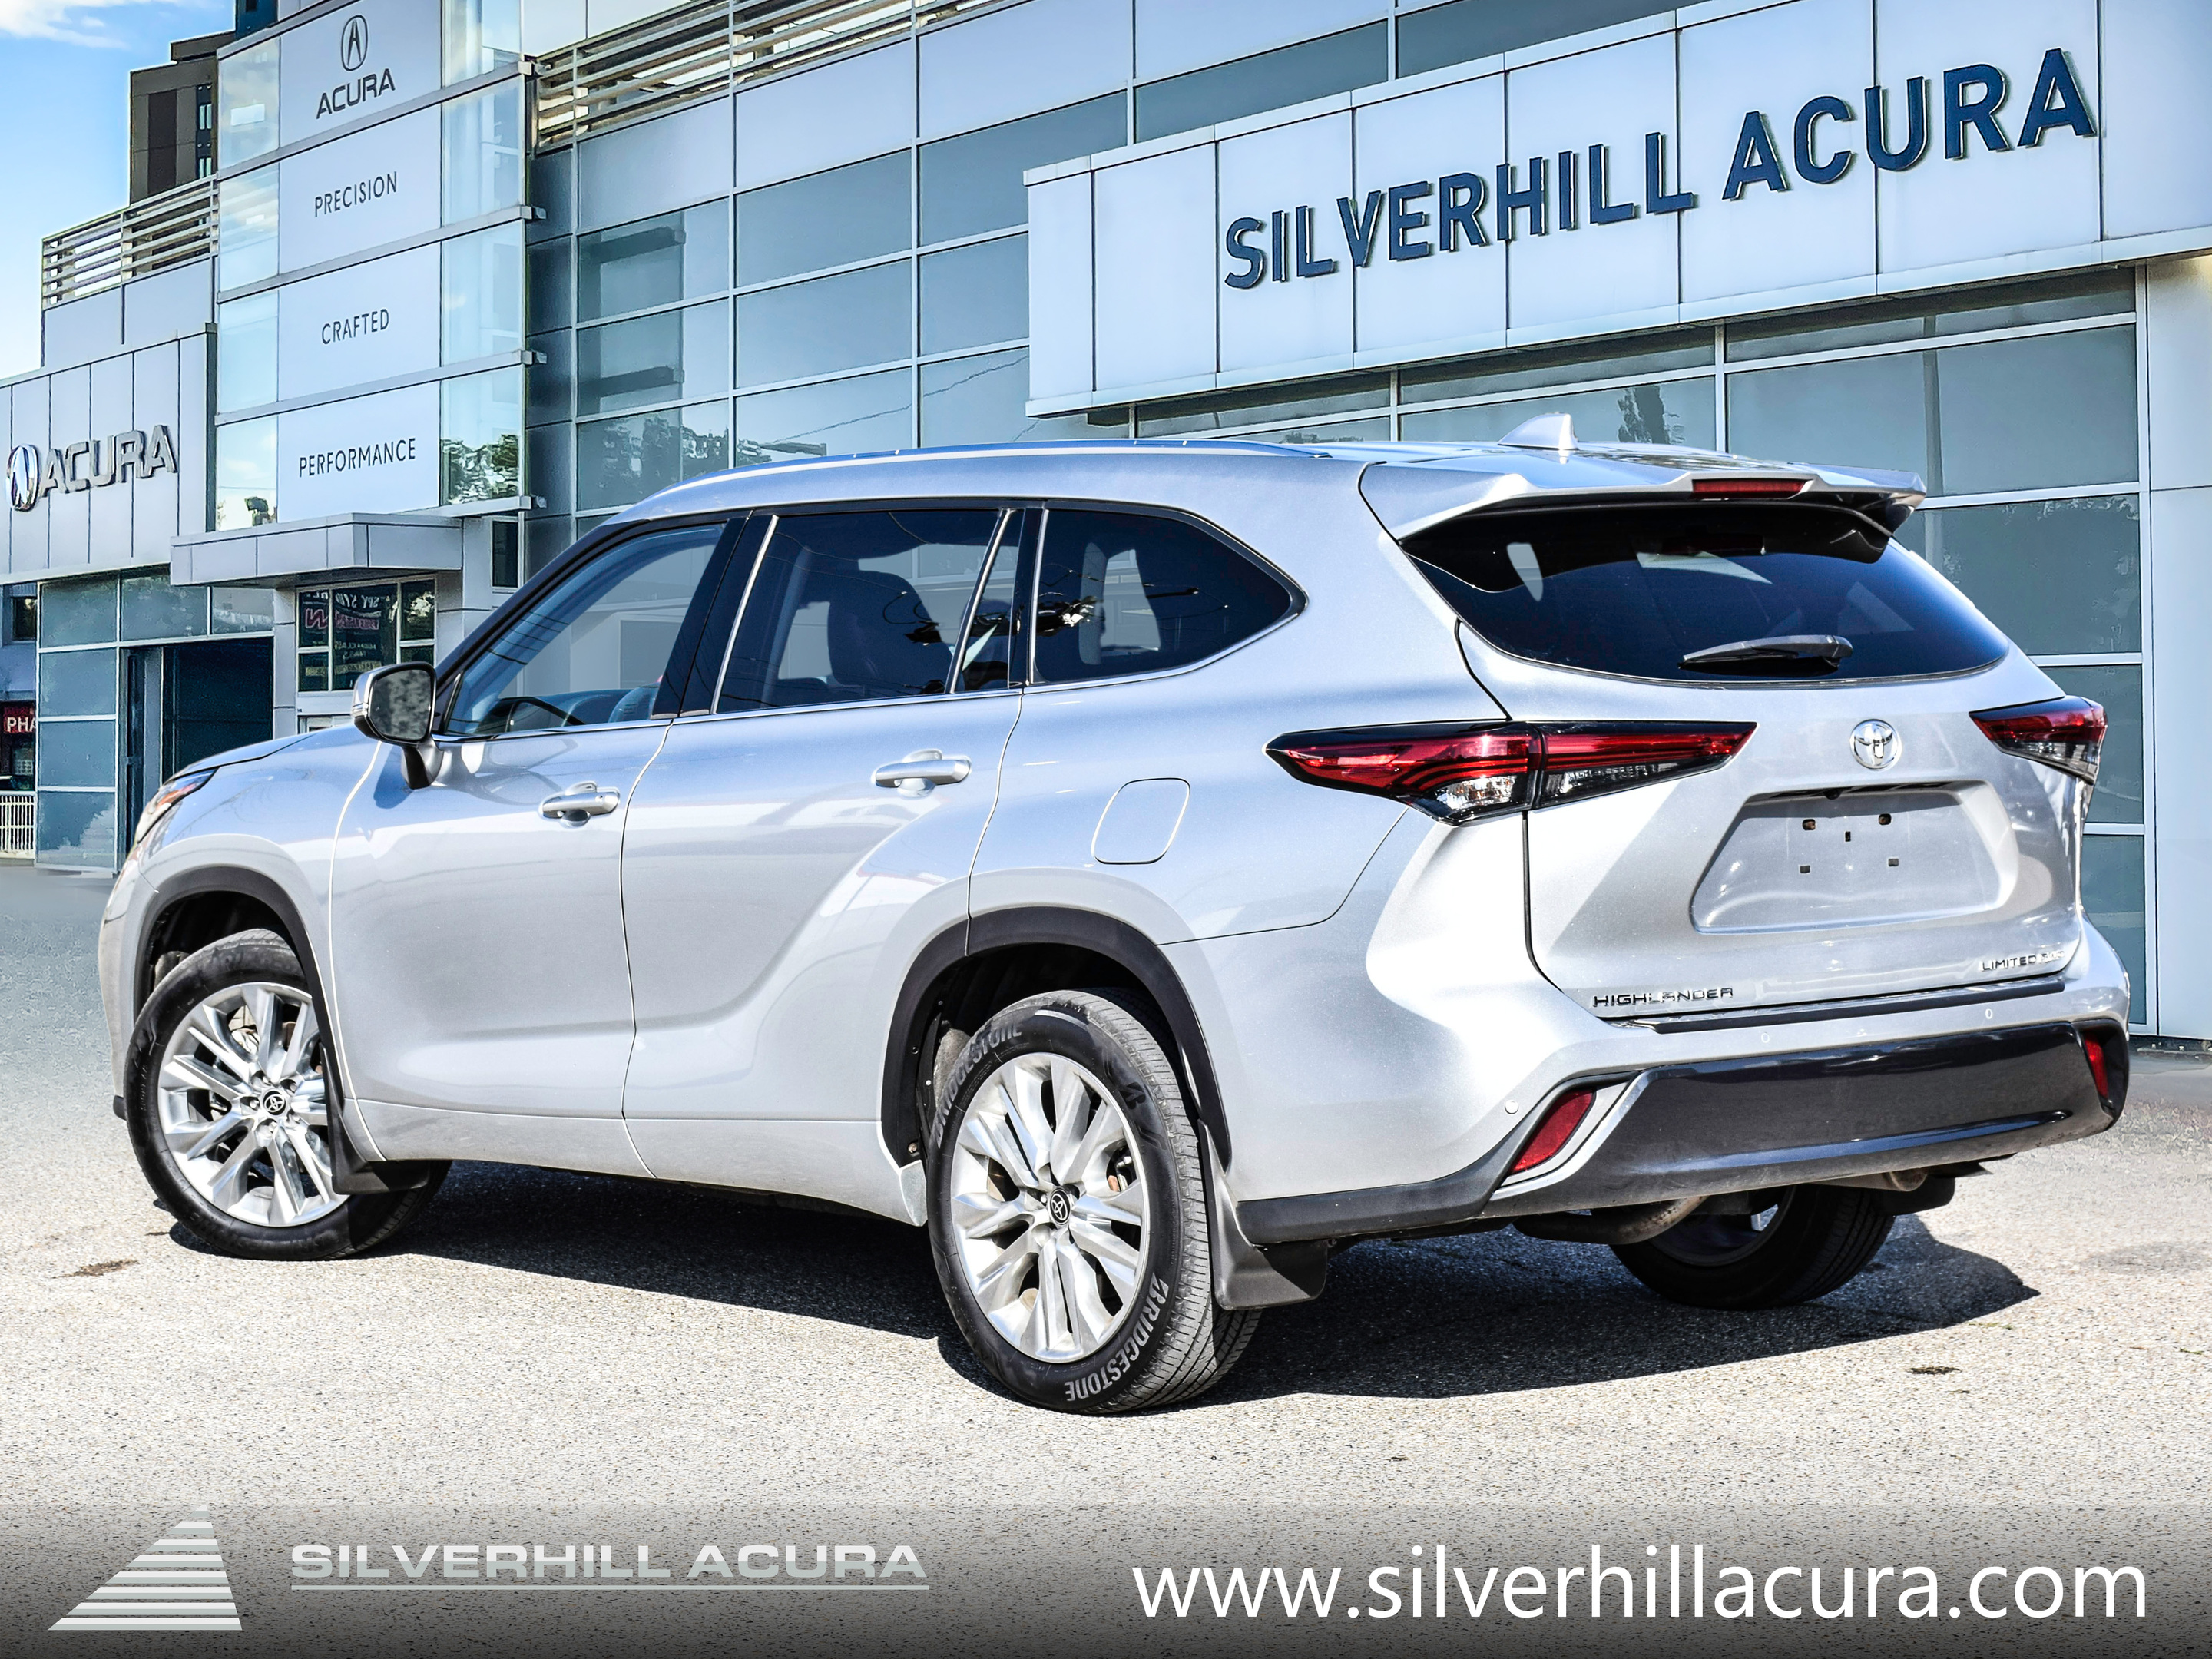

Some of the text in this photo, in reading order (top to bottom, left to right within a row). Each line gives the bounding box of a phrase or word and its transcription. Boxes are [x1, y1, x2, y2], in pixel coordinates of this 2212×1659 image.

[316, 68, 396, 118] ACURA
[1224, 48, 2098, 289] SILVERHILL ACURA
[315, 171, 397, 217] PRECISION
[322, 309, 389, 345] CRAFTED
[40, 425, 177, 498] ACURA
[300, 439, 416, 478] PERFORMANCE
[1979, 955, 2037, 972] LIMITED
[1592, 987, 1734, 1008] HIGHLANDER
[934, 1024, 1022, 1149] BRIDGESTONE
[1065, 1272, 1169, 1402] BRIDGESTONE
